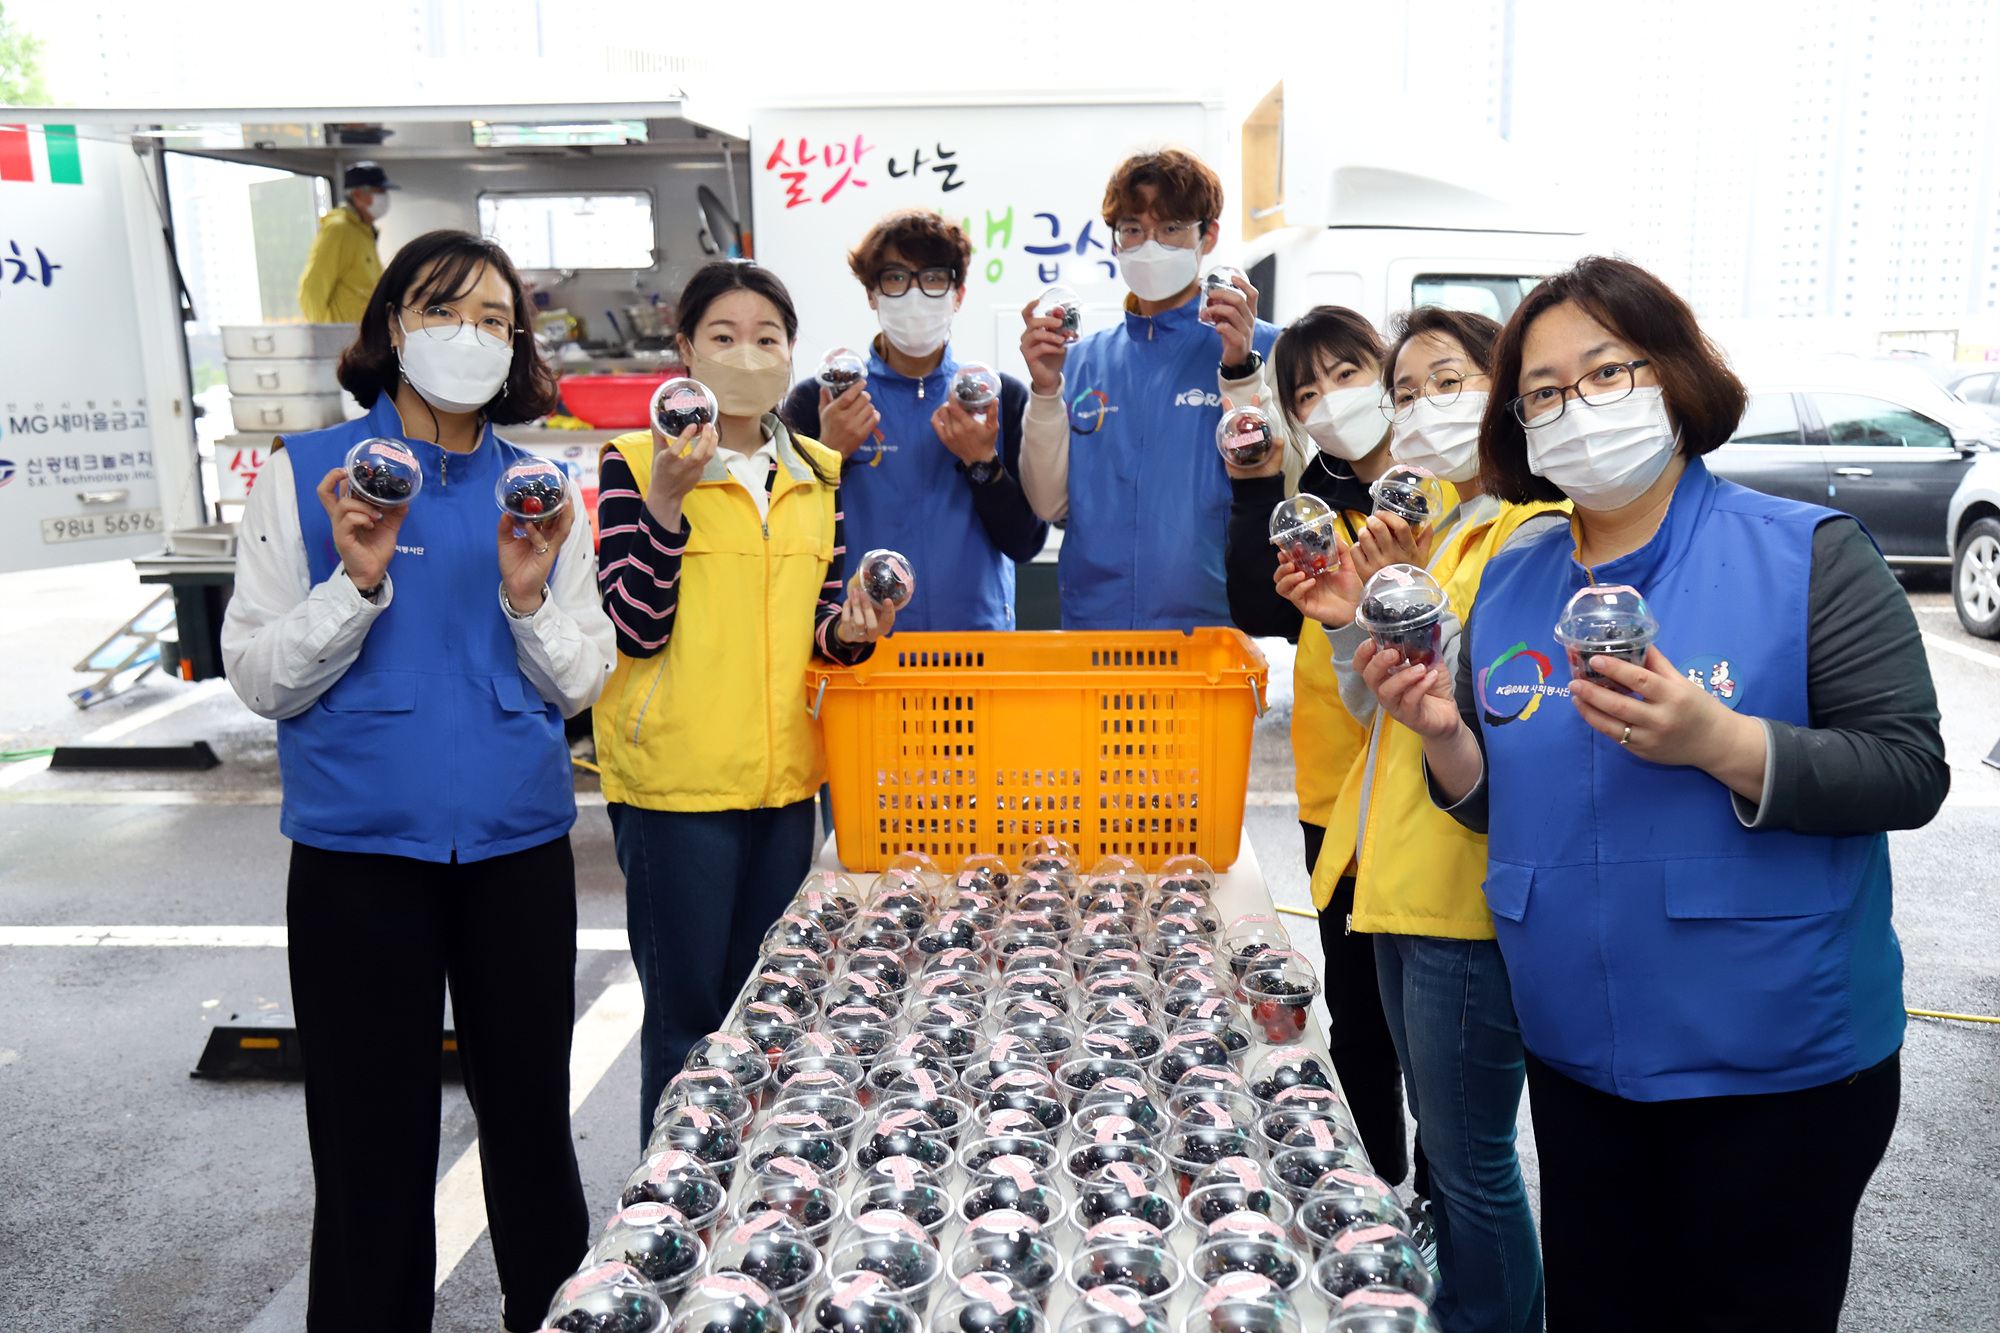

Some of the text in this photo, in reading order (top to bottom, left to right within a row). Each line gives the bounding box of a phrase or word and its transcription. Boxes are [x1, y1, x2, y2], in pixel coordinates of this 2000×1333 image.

[766, 133, 965, 209] 살맛 나는
[104, 512, 156, 534] 5696
